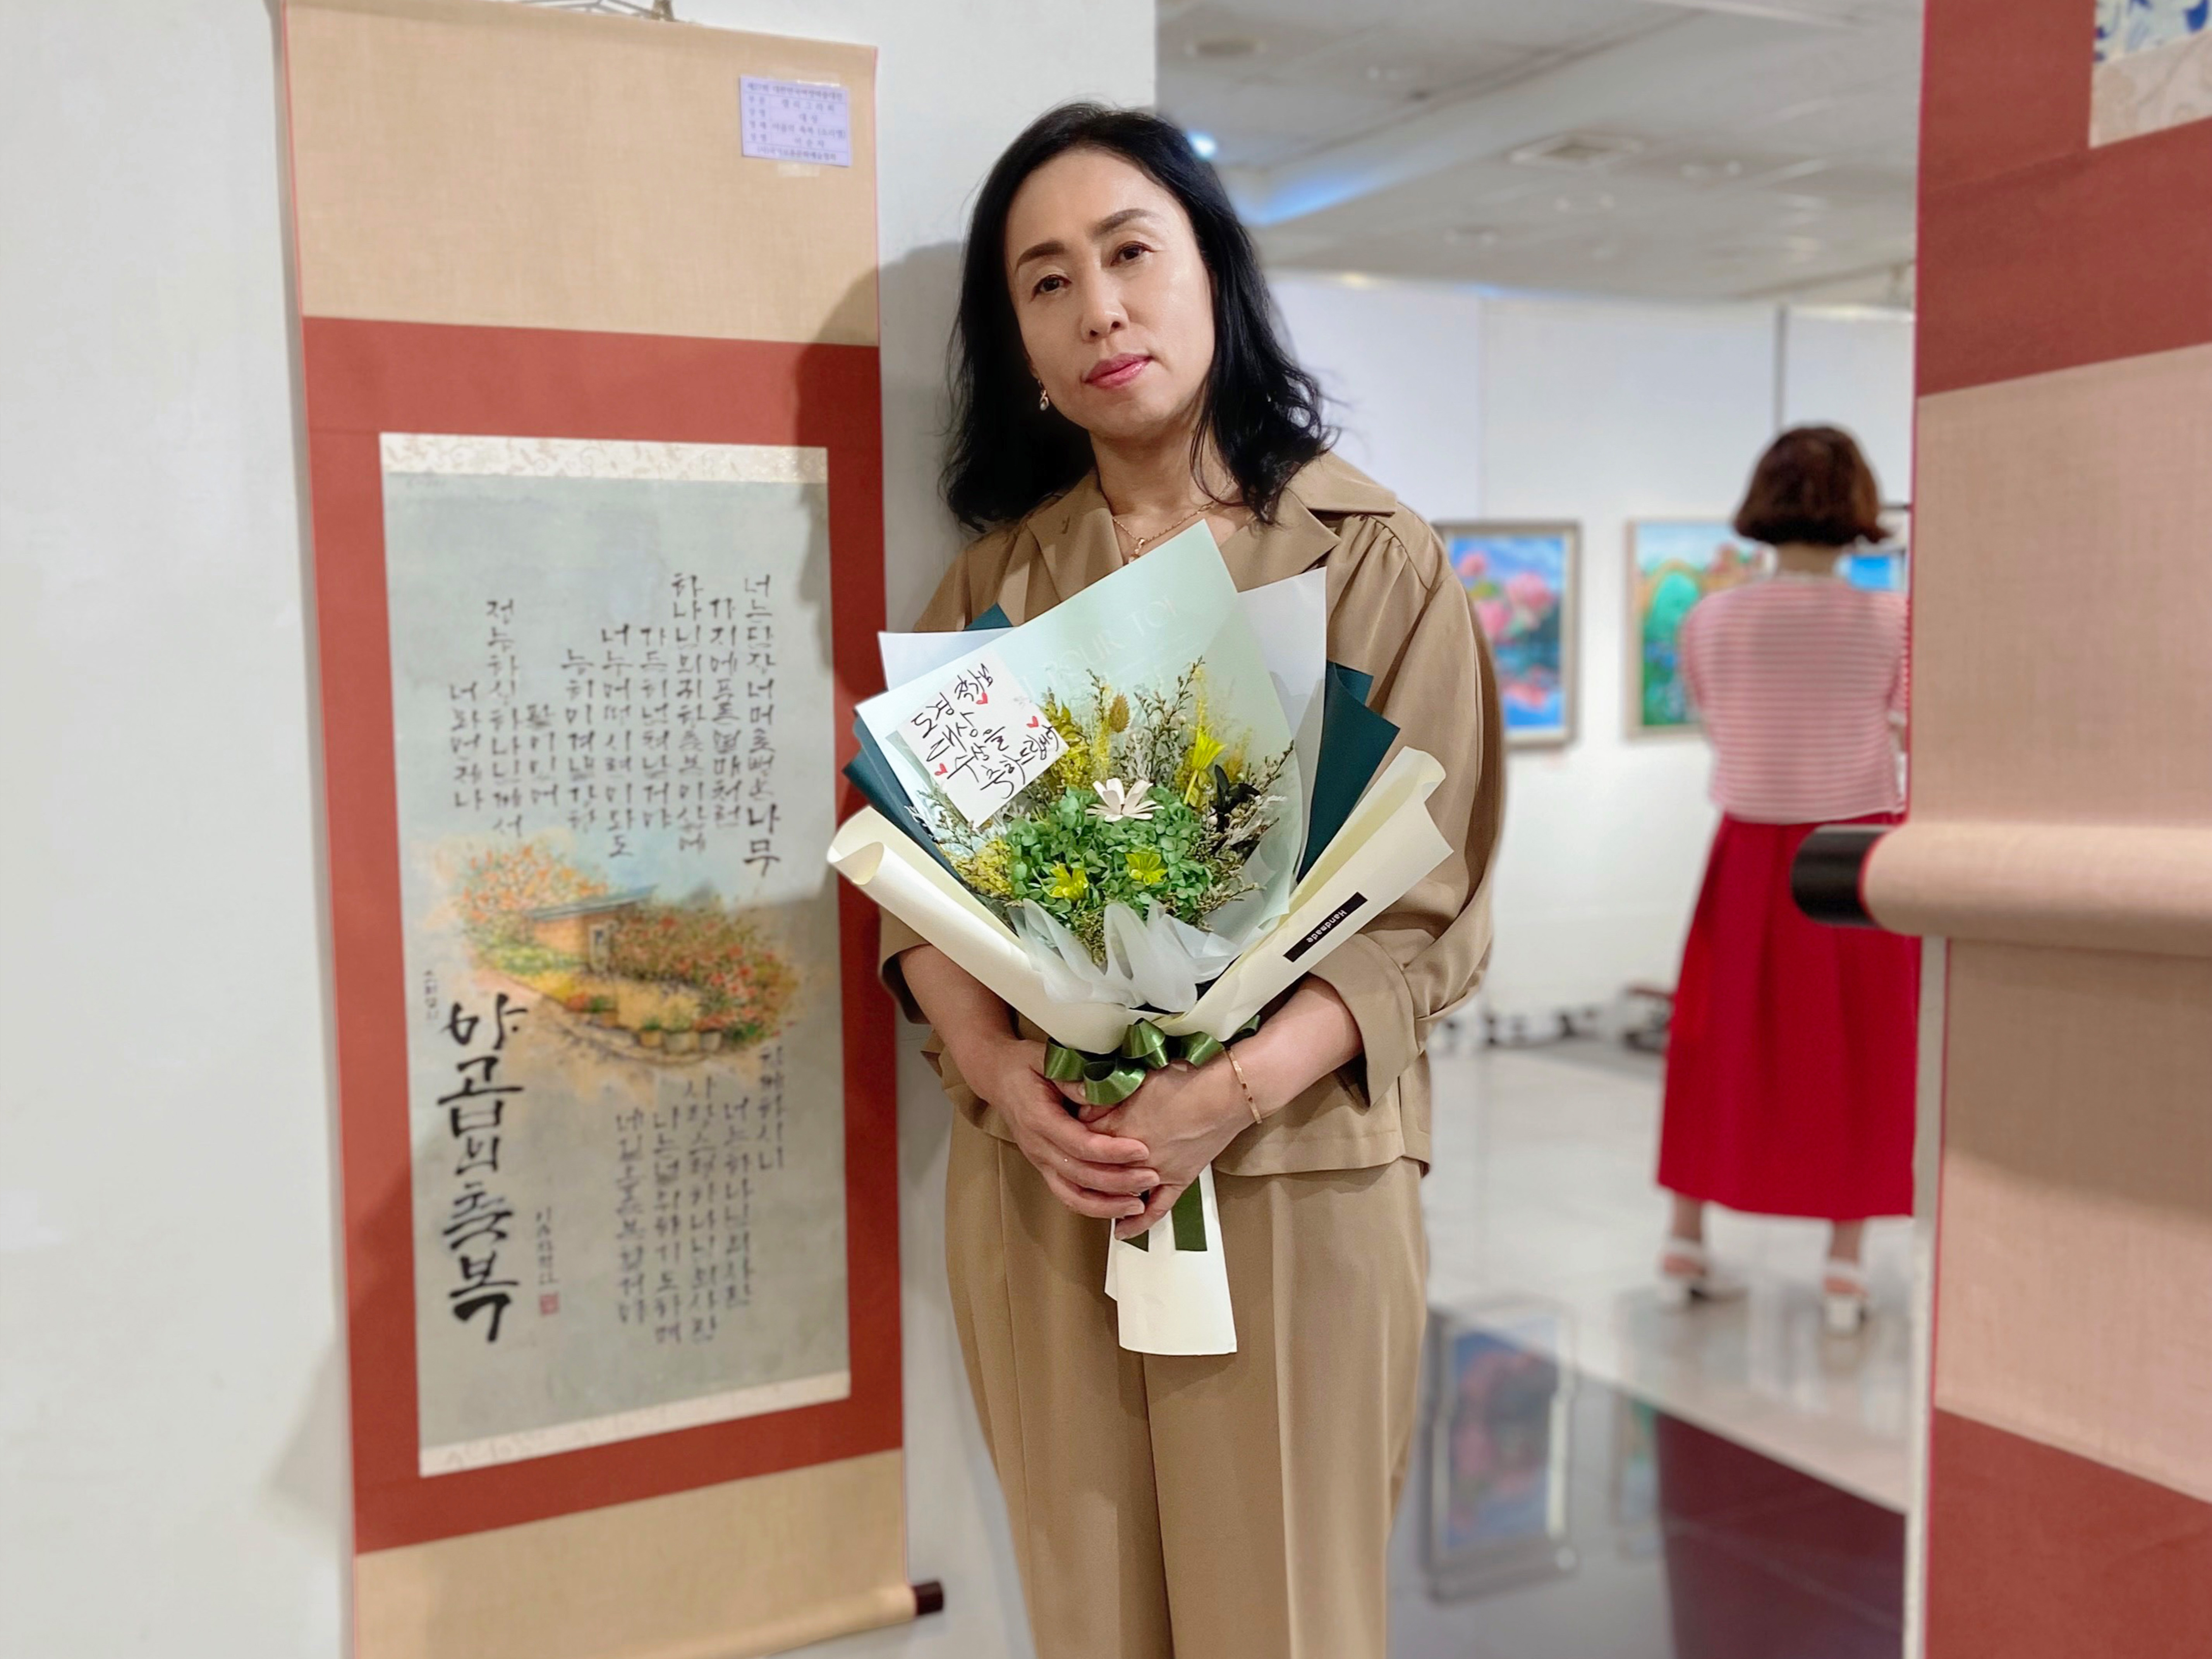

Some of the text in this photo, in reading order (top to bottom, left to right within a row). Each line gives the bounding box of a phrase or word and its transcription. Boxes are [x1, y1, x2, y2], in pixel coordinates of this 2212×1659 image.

[672, 572, 704, 675] 하나님의
[745, 574, 773, 623] 너는
[640, 627, 669, 699] 가득히
[709, 598, 737, 676] 가지에
[746, 625, 776, 675] 담장
[560, 648, 595, 700] 능히
[486, 598, 523, 840] 전능하신 하나님께서
[747, 678, 775, 754] 너머로
[926, 711, 980, 762] 대상
[712, 728, 742, 830] 열매처럼
[980, 724, 1060, 799] 축하드립니다
[607, 807, 635, 858] 와도
[642, 781, 672, 830] 거야
[743, 803, 781, 878] 나무
[1306, 910, 1347, 943] Handmade
[443, 1181, 520, 1344] 축복
